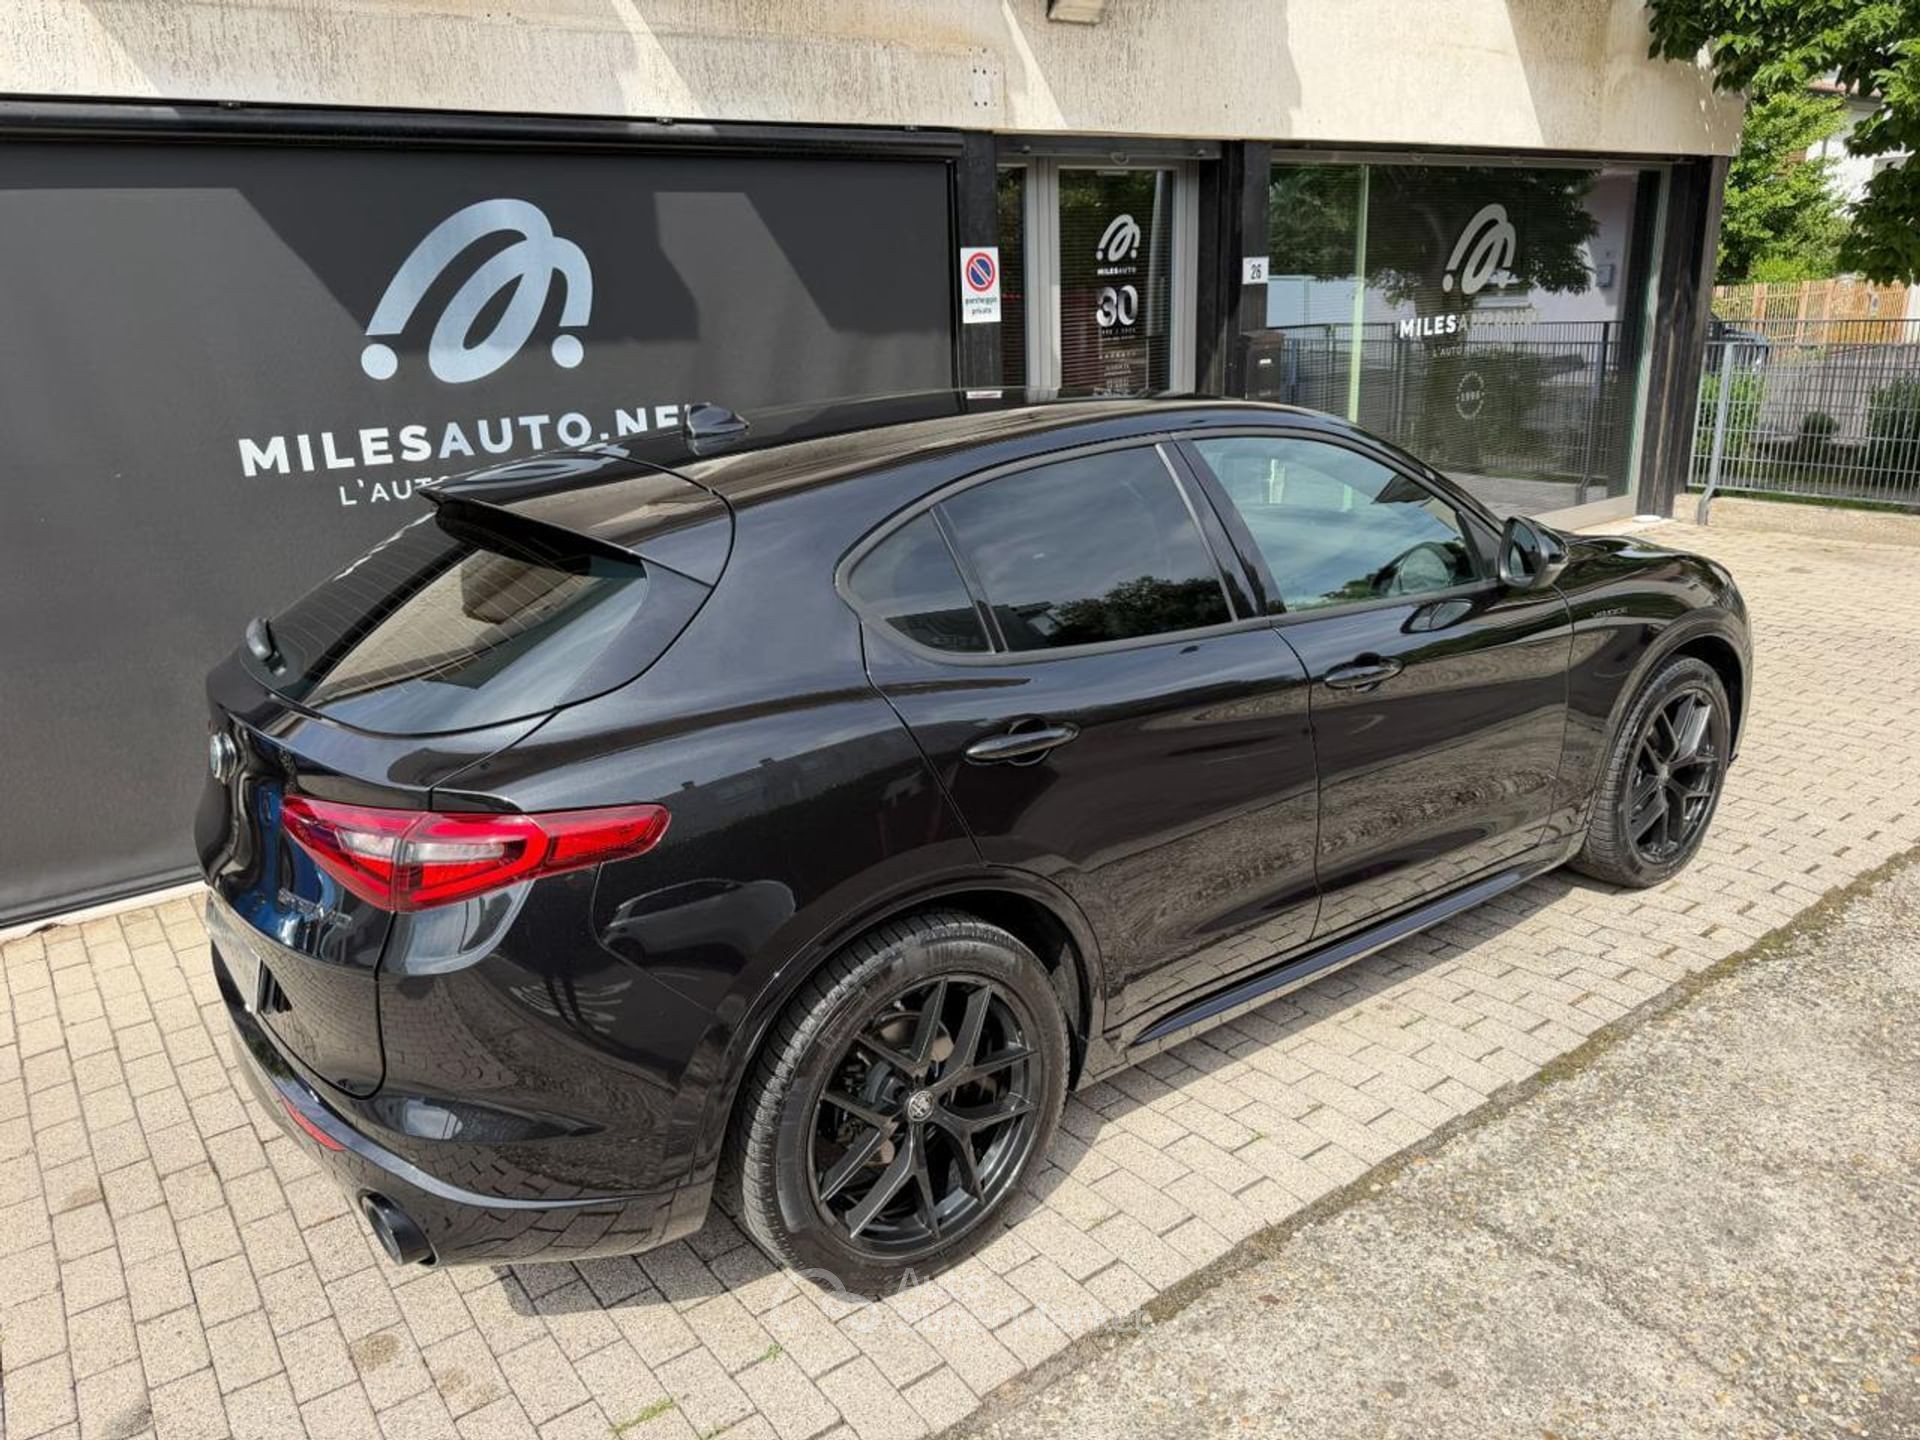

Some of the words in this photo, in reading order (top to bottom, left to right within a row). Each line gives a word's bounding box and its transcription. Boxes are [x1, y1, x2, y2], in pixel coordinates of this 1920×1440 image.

[1250, 263, 1262, 280] 26
[1096, 285, 1139, 327] 30
[238, 404, 691, 477] MILESAUTO.NE
[339, 476, 449, 506] L'AUT
